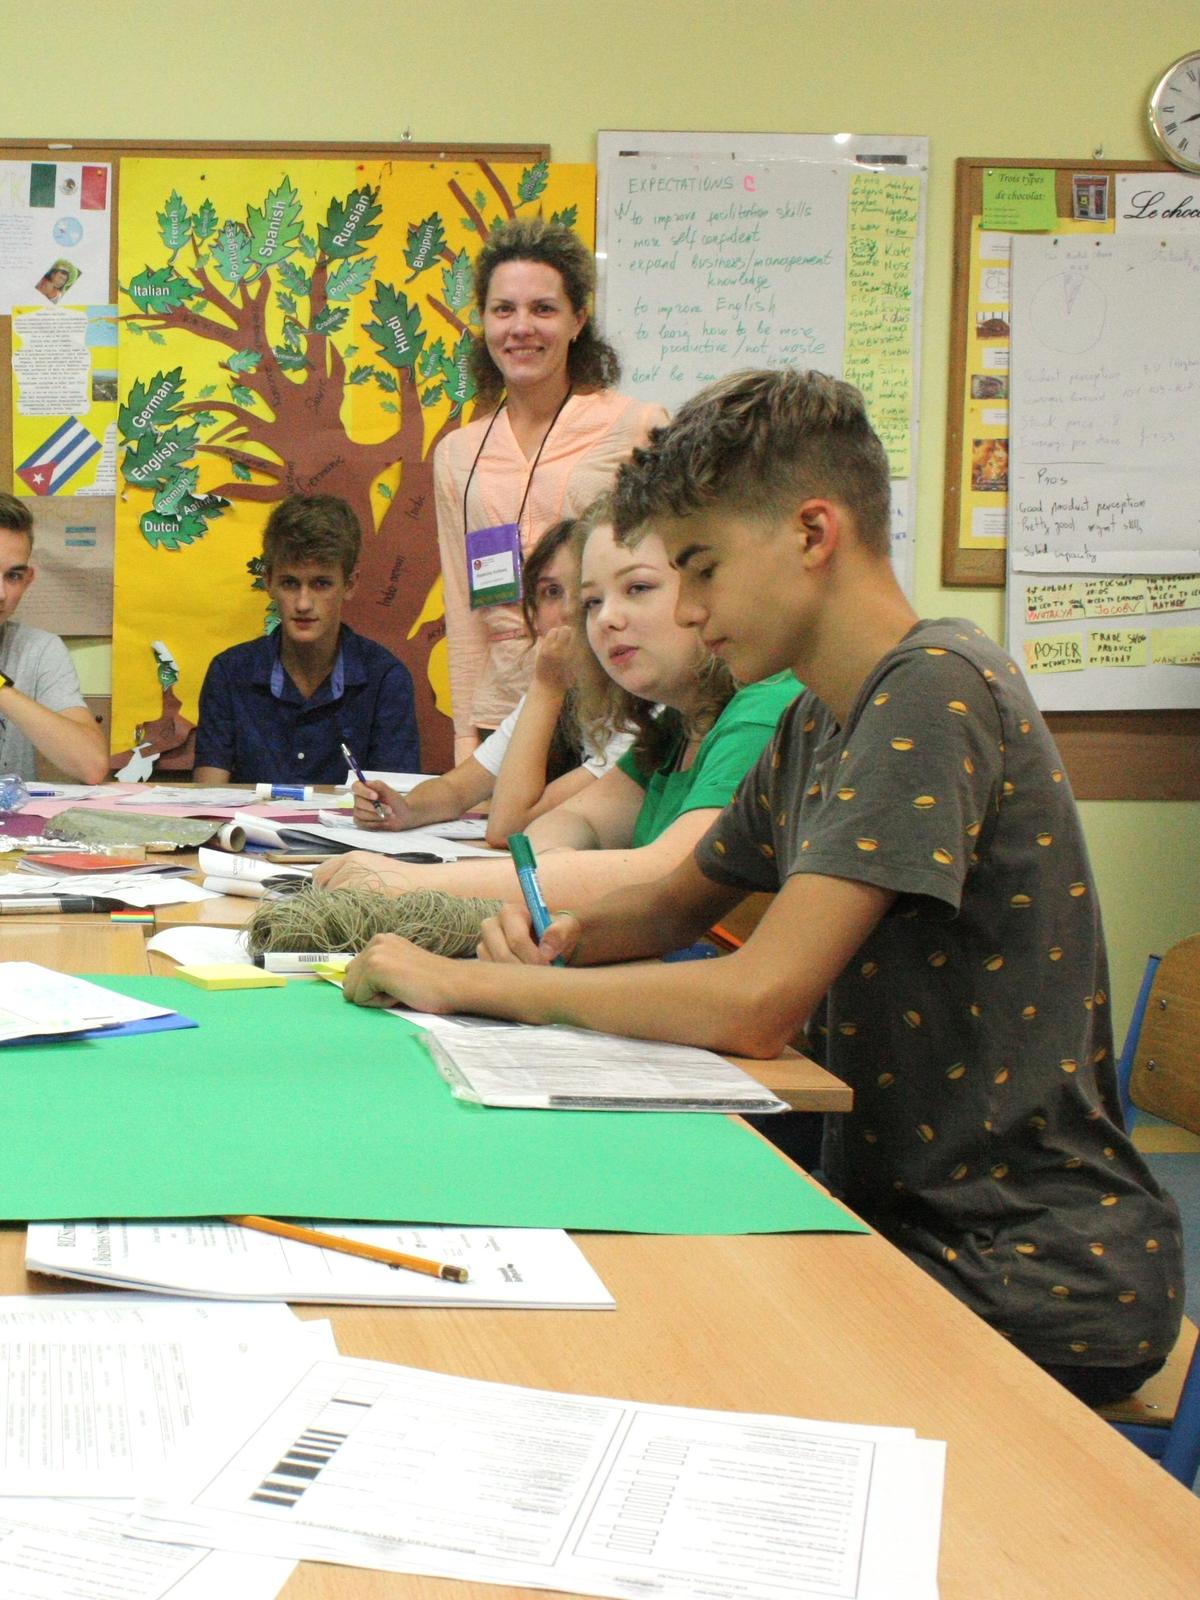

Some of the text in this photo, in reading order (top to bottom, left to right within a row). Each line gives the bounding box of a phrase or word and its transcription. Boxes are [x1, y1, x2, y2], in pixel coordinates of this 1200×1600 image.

[628, 176, 734, 194] EXPECTATIONS
[999, 173, 1045, 187] Trois types
[994, 191, 1006, 201] de
[1123, 190, 1166, 220] Le
[332, 194, 370, 248] Russian
[776, 201, 812, 219] skills
[168, 209, 180, 247] French
[258, 200, 286, 258] Spanish
[413, 224, 434, 269] Bhojpuri
[629, 251, 677, 271] expand
[133, 286, 170, 298] Italian
[329, 271, 359, 297] Polish
[451, 268, 465, 307] Magahi
[707, 270, 771, 293] knowledge
[633, 297, 649, 316] to
[716, 293, 777, 320] English
[315, 311, 343, 332] Croatian
[635, 324, 649, 340] to
[701, 321, 728, 336] how
[735, 321, 747, 336] to
[756, 320, 771, 336] be
[386, 315, 410, 355] Hindi
[781, 337, 827, 354] waste
[455, 352, 469, 399] Awadhi
[132, 380, 174, 430] German
[130, 439, 180, 483] English
[157, 477, 190, 510] Flemish
[1018, 493, 1146, 517] Good product perception
[144, 520, 180, 532] Dutch
[1054, 518, 1076, 535] good
[1090, 631, 1122, 643] TRADE
[1097, 643, 1133, 653] PRODUCT
[1034, 641, 1082, 661] POSTER
